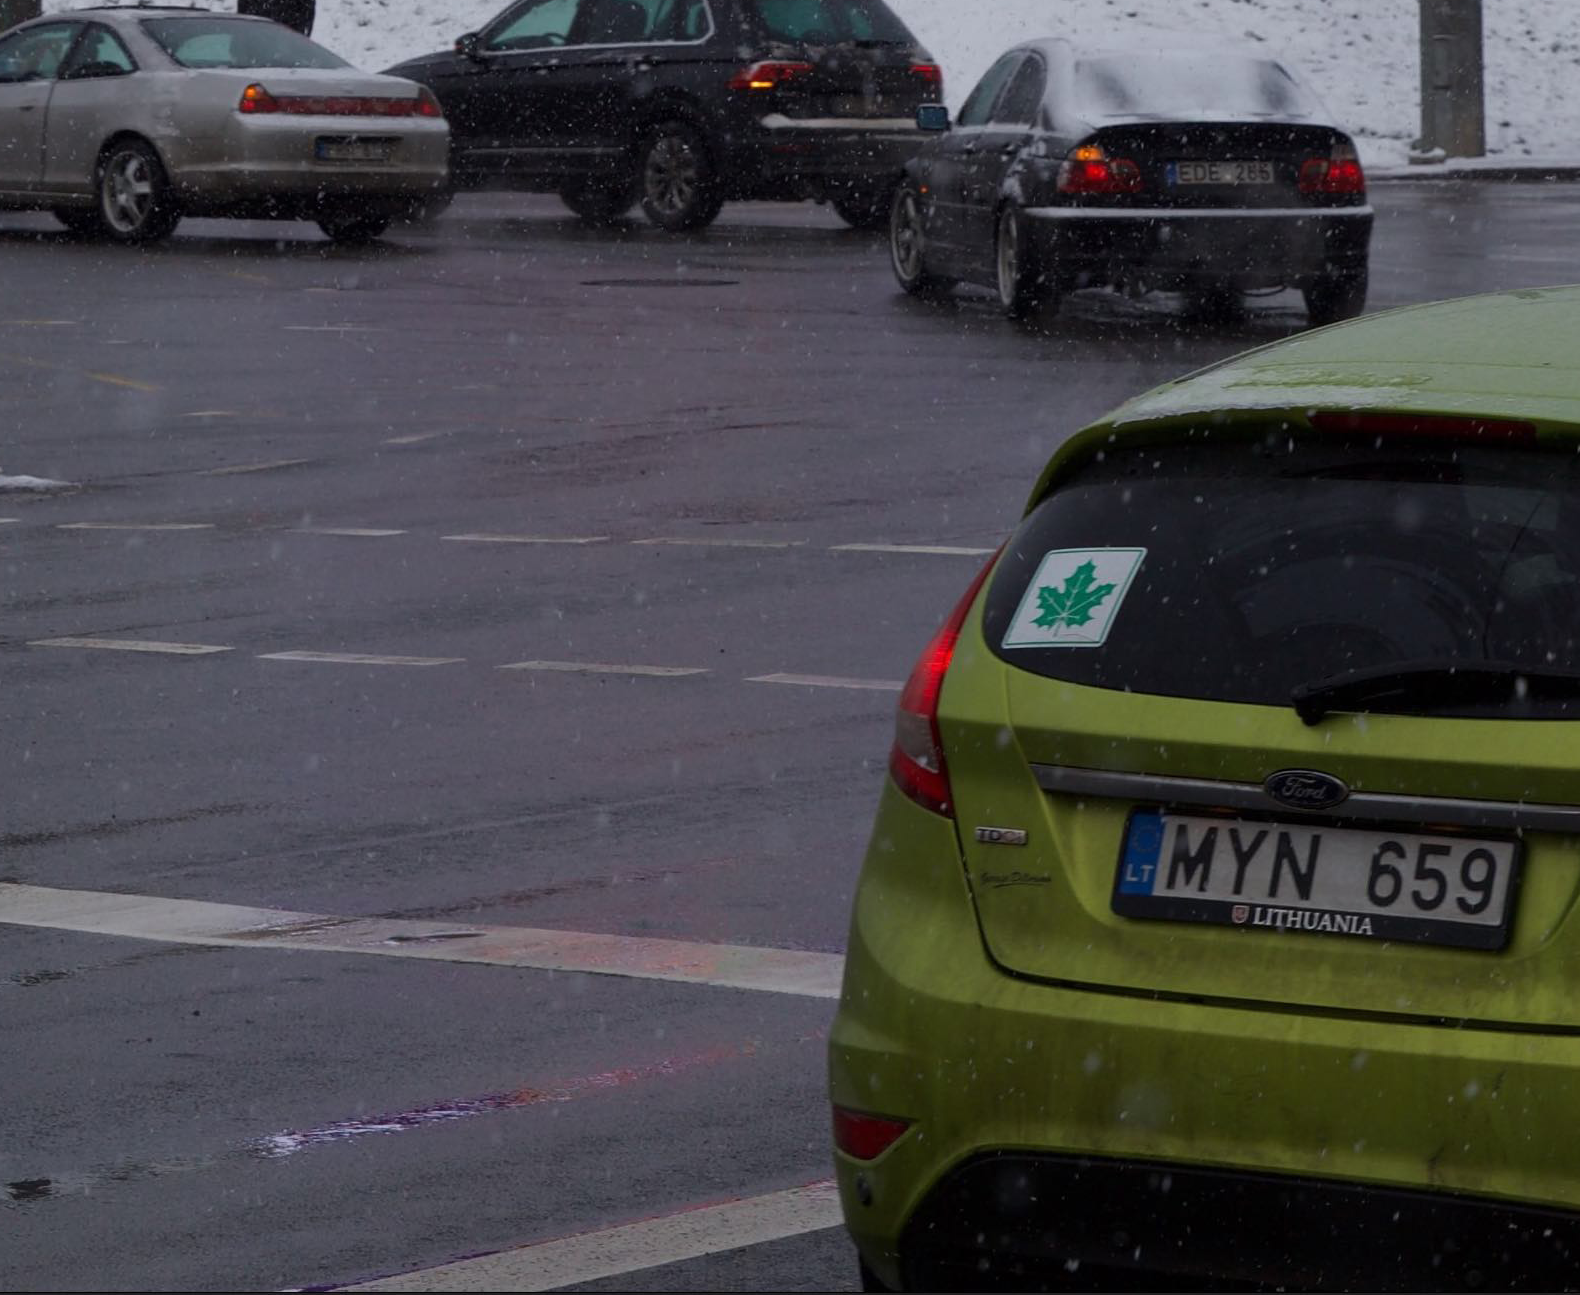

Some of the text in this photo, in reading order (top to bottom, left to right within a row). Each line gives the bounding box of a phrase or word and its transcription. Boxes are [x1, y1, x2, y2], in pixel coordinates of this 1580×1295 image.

[1179, 164, 1220, 181] EDE
[1281, 778, 1328, 802] Ford
[1125, 864, 1154, 883] LT
[1166, 824, 1497, 915] MYN 659
[1253, 909, 1373, 936] LITHUANIA
